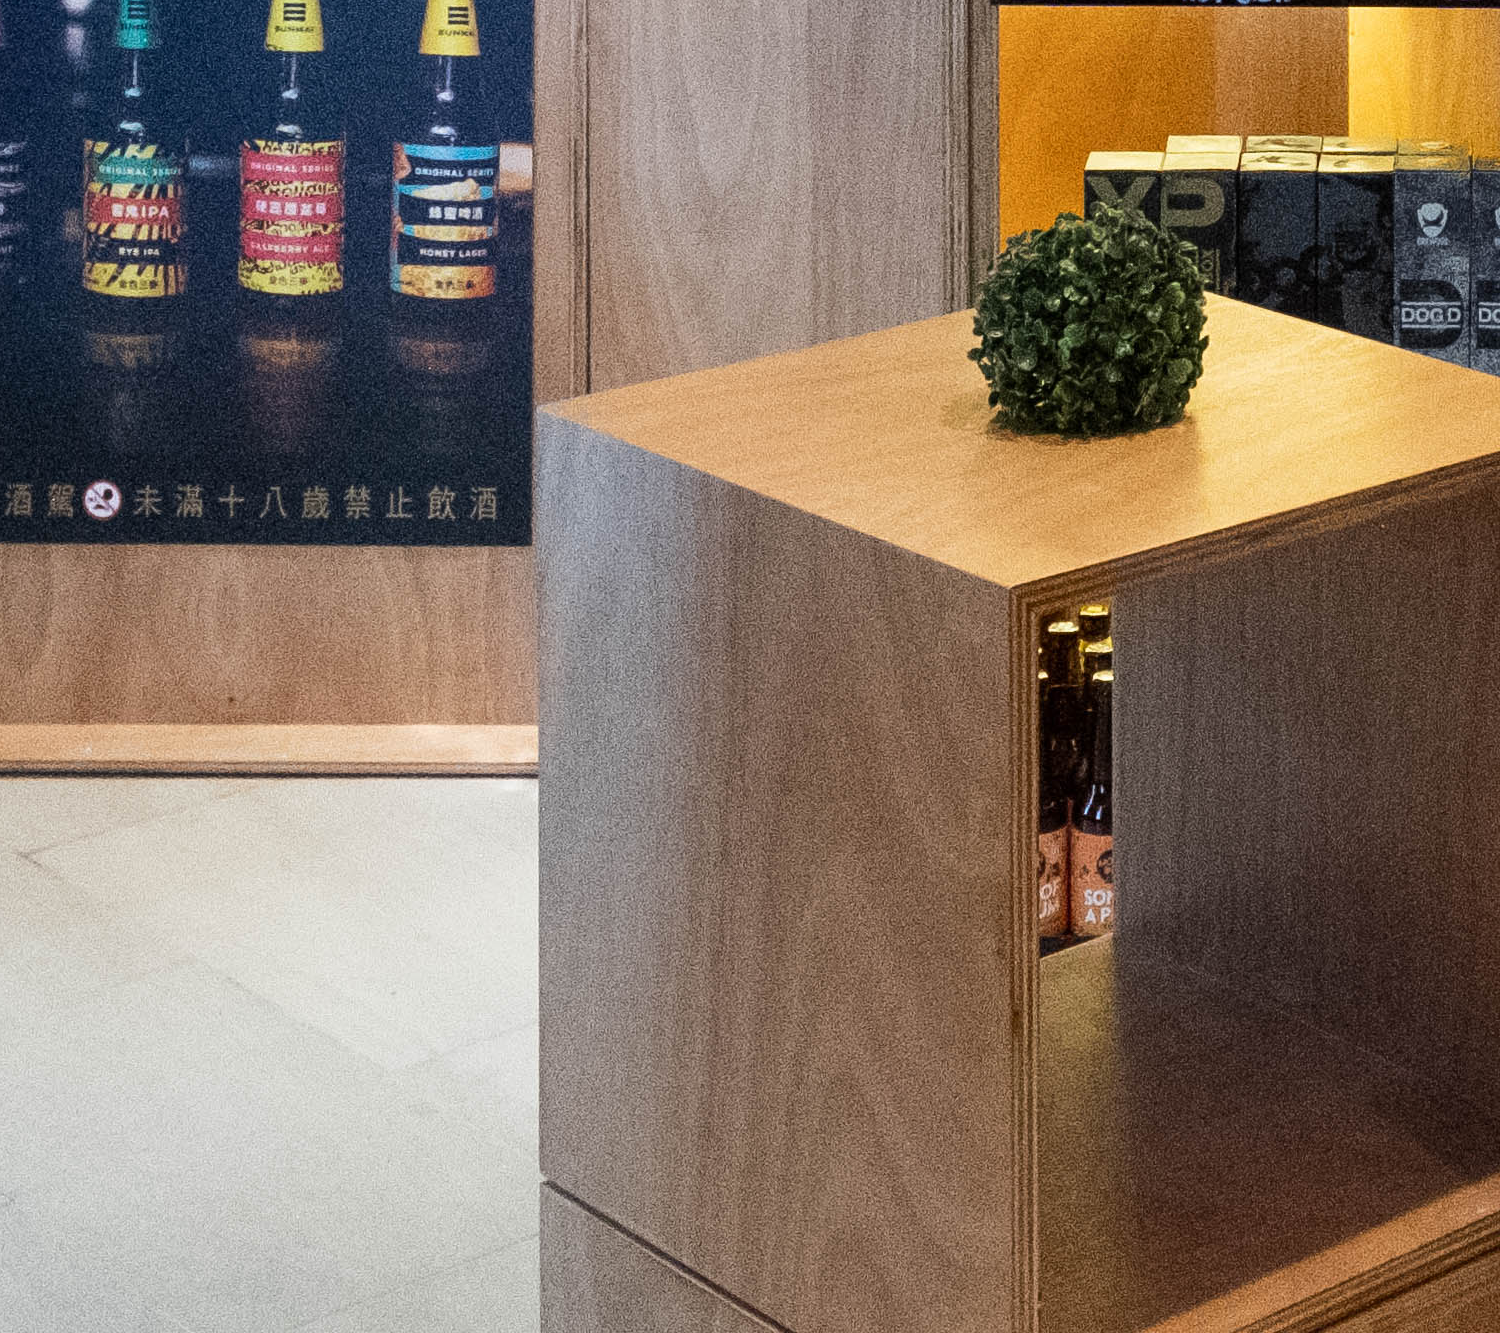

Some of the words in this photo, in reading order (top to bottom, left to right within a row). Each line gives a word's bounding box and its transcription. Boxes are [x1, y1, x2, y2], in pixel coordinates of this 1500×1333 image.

[251, 163, 297, 173] ORIGINAL
[415, 168, 464, 178] ORIGINAL
[134, 484, 498, 519] 未滿十八歲禁止飲酒
